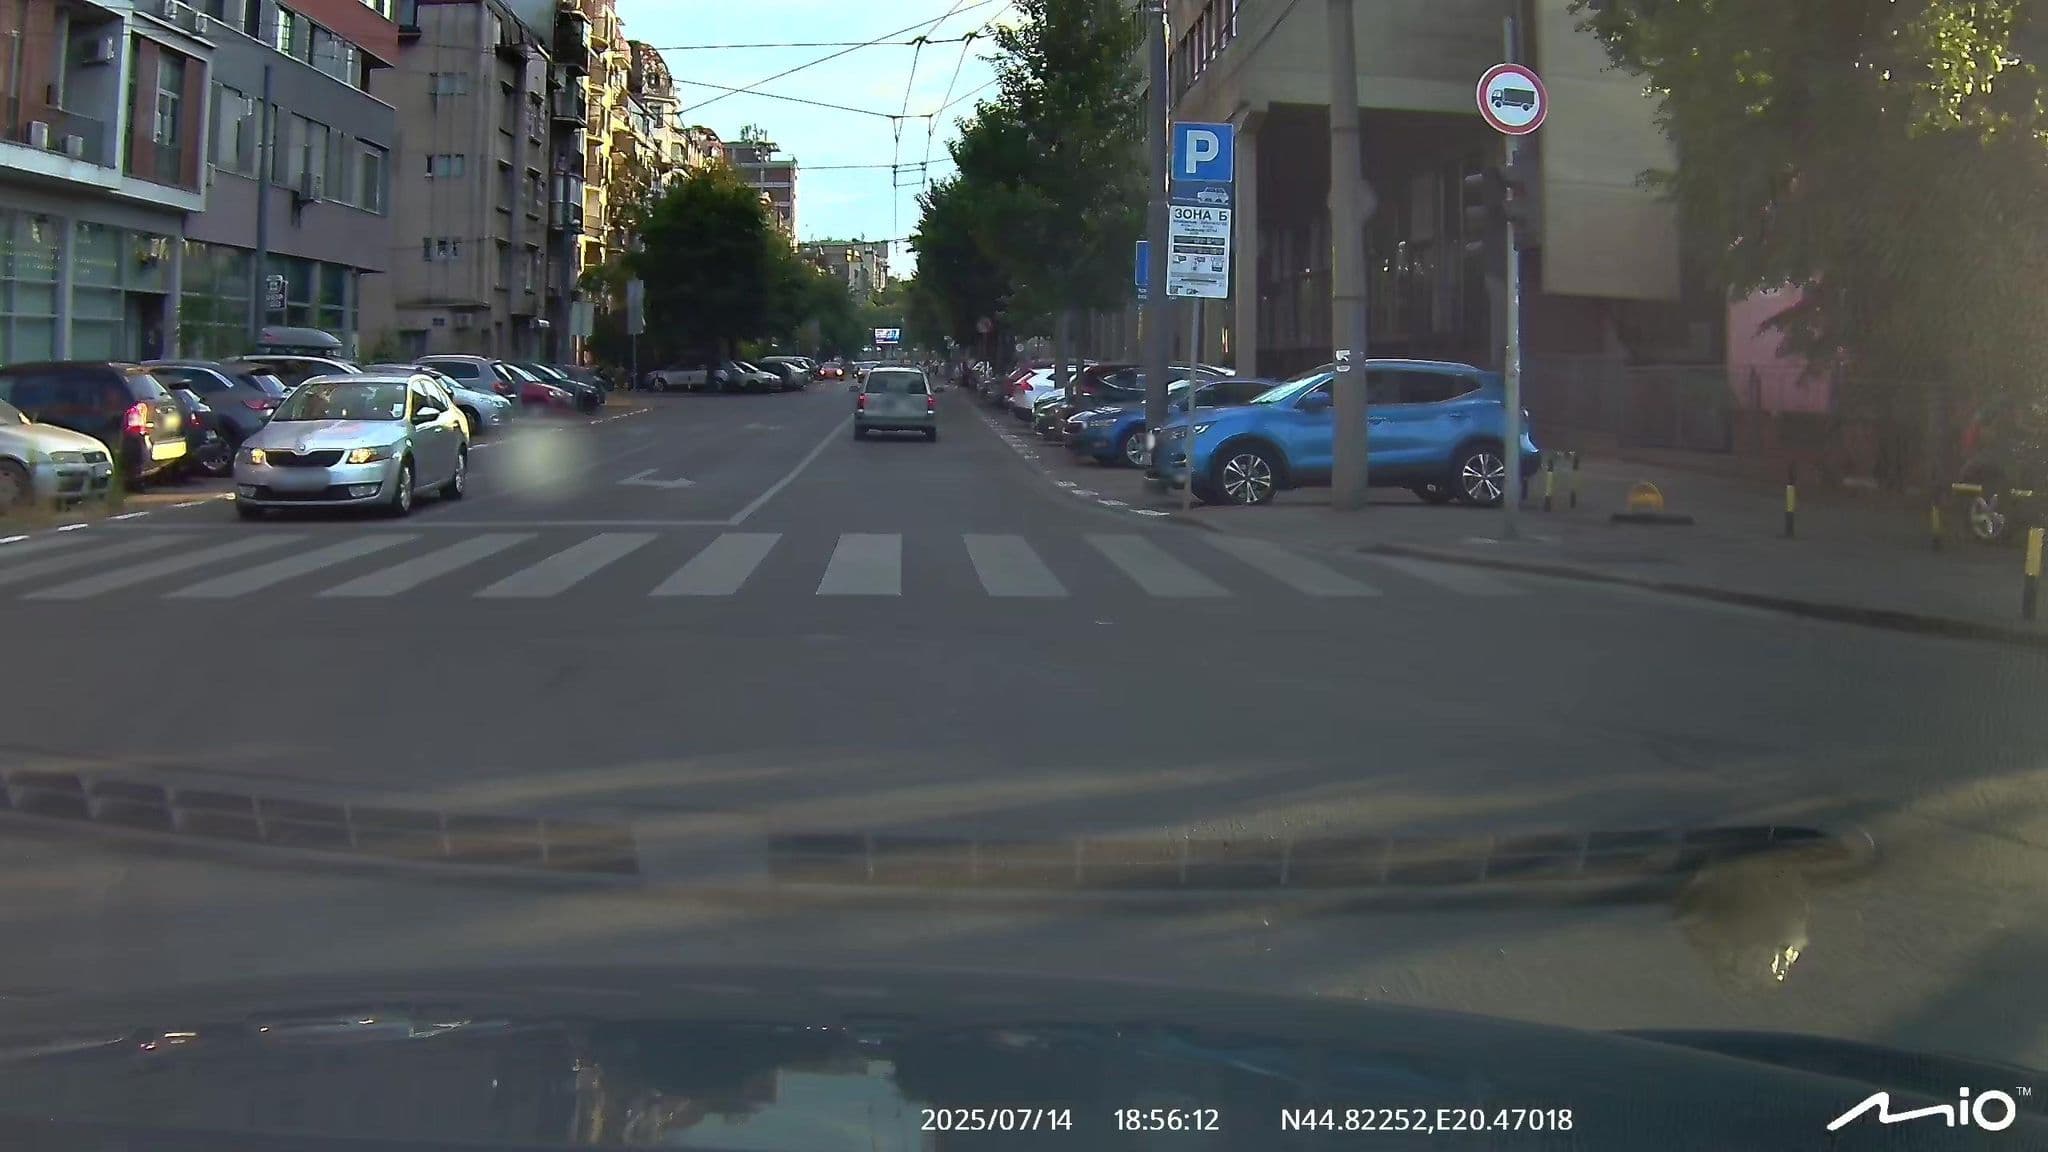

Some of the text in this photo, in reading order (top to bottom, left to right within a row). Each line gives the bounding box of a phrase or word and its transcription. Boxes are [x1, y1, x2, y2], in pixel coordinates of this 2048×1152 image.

[1185, 129, 1219, 174] P
[1175, 208, 1228, 221] ЗОНА Б
